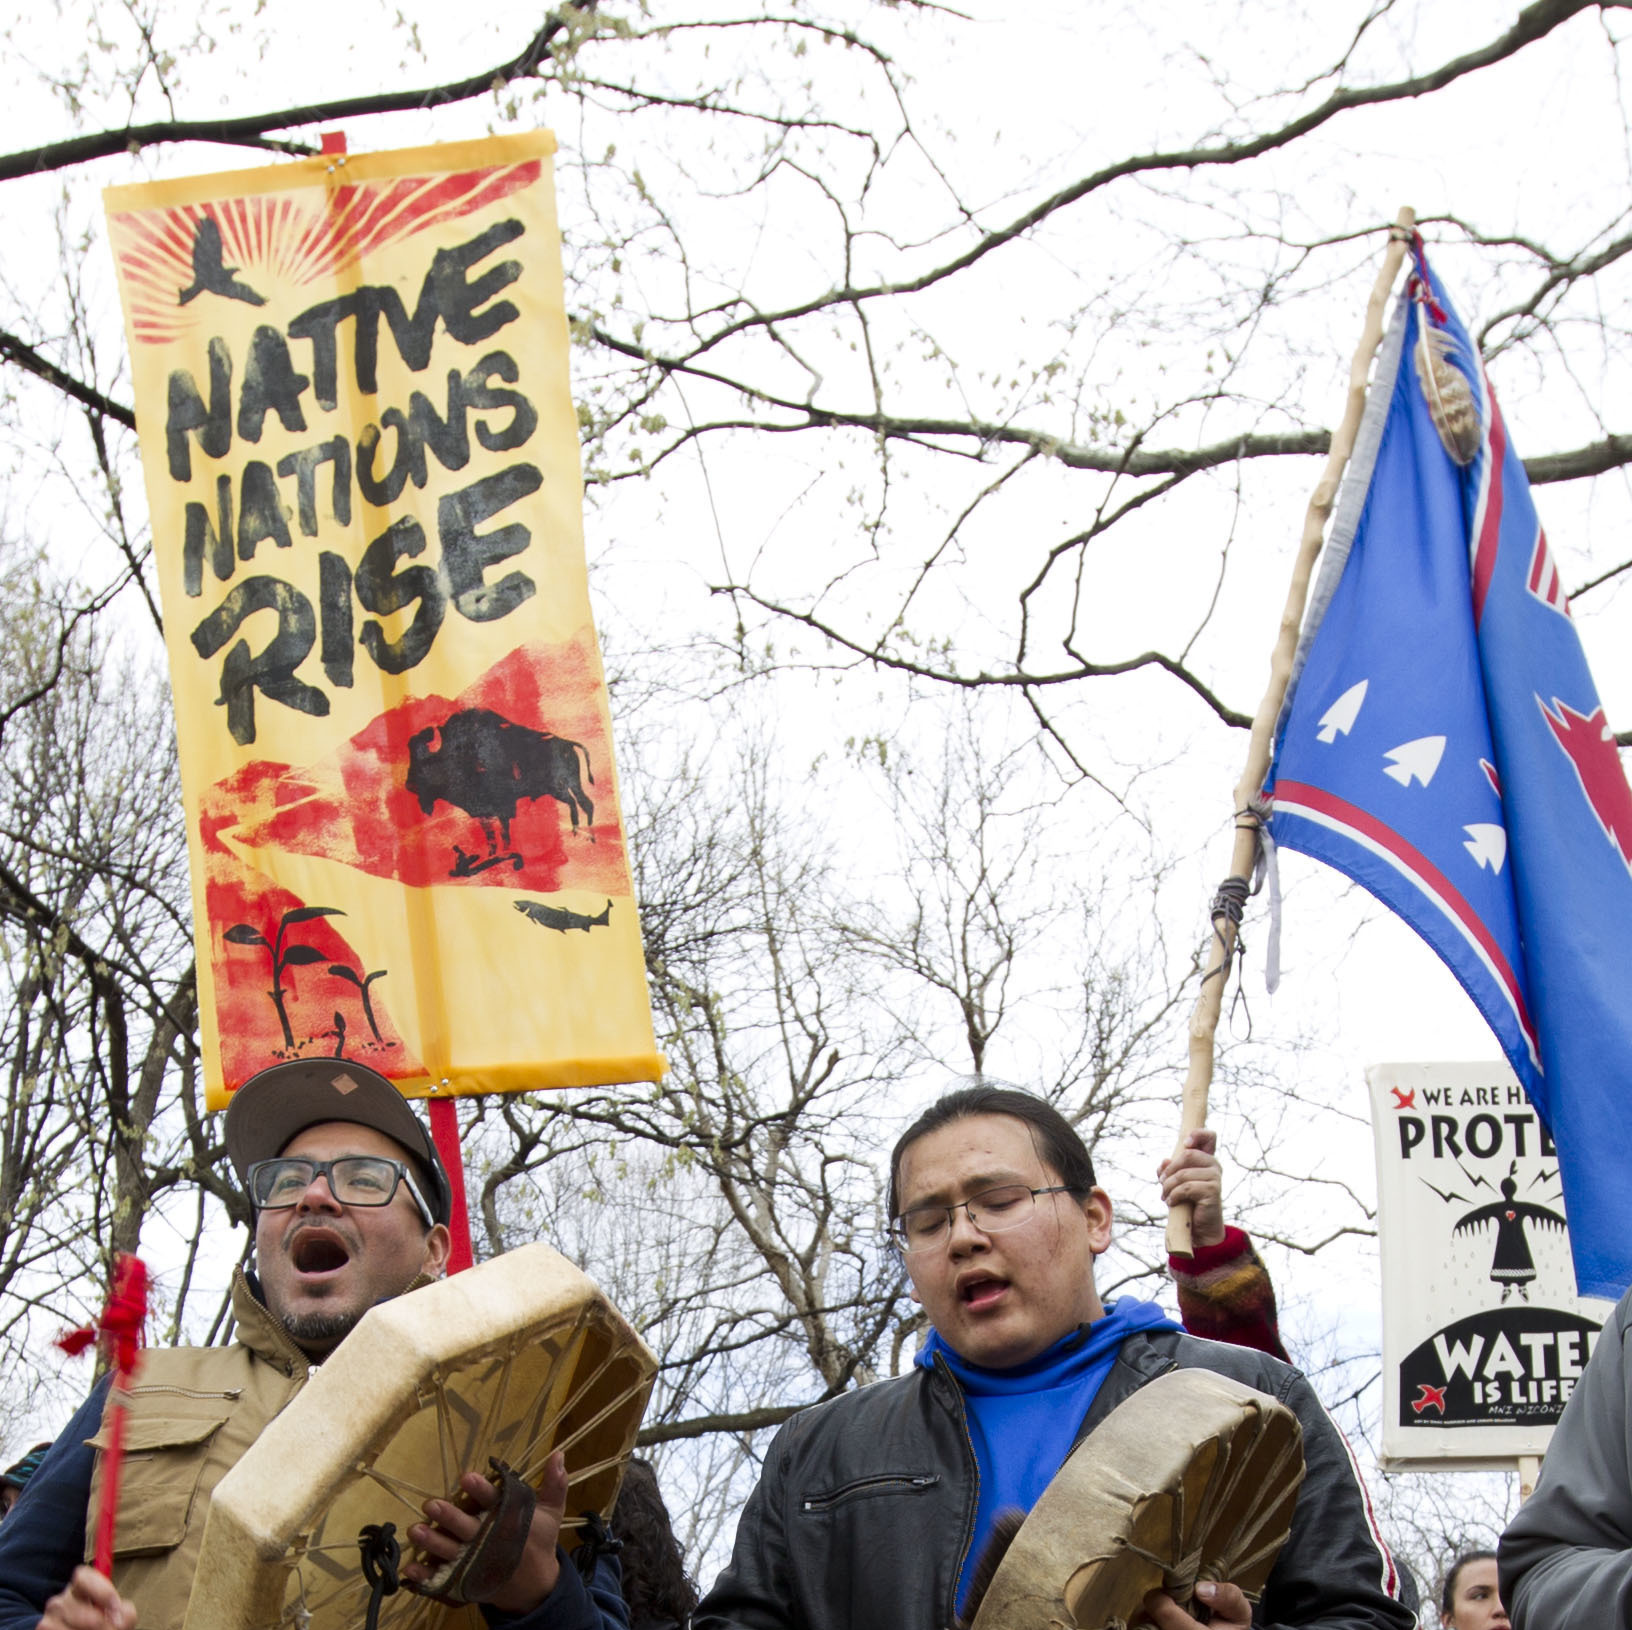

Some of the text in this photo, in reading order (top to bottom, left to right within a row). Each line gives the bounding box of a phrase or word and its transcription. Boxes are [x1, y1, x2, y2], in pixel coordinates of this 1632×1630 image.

[166, 218, 525, 482] NATIVE
[183, 350, 537, 597] NATIONS
[189, 462, 544, 745] RISE
[1422, 1087, 1454, 1106] WE
[1459, 1086, 1500, 1106] ARE
[1473, 1379, 1575, 1404] IS LIFE
